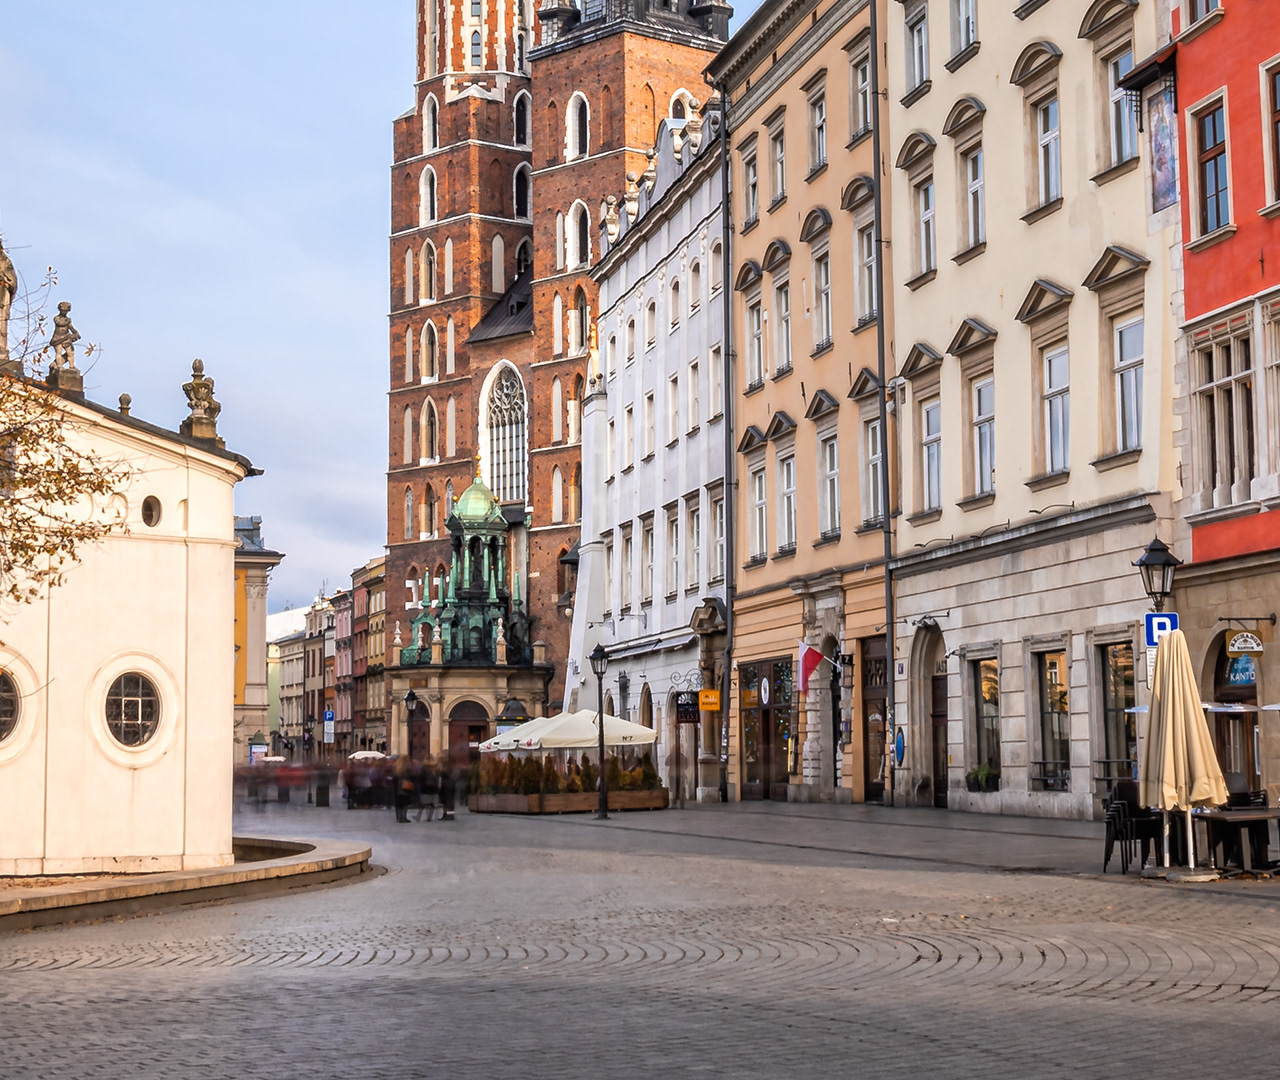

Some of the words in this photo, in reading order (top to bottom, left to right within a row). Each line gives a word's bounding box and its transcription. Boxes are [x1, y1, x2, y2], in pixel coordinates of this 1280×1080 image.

[1152, 616, 1172, 643] P
[1230, 633, 1262, 648] EXCHANGE
[326, 711, 333, 720] P
